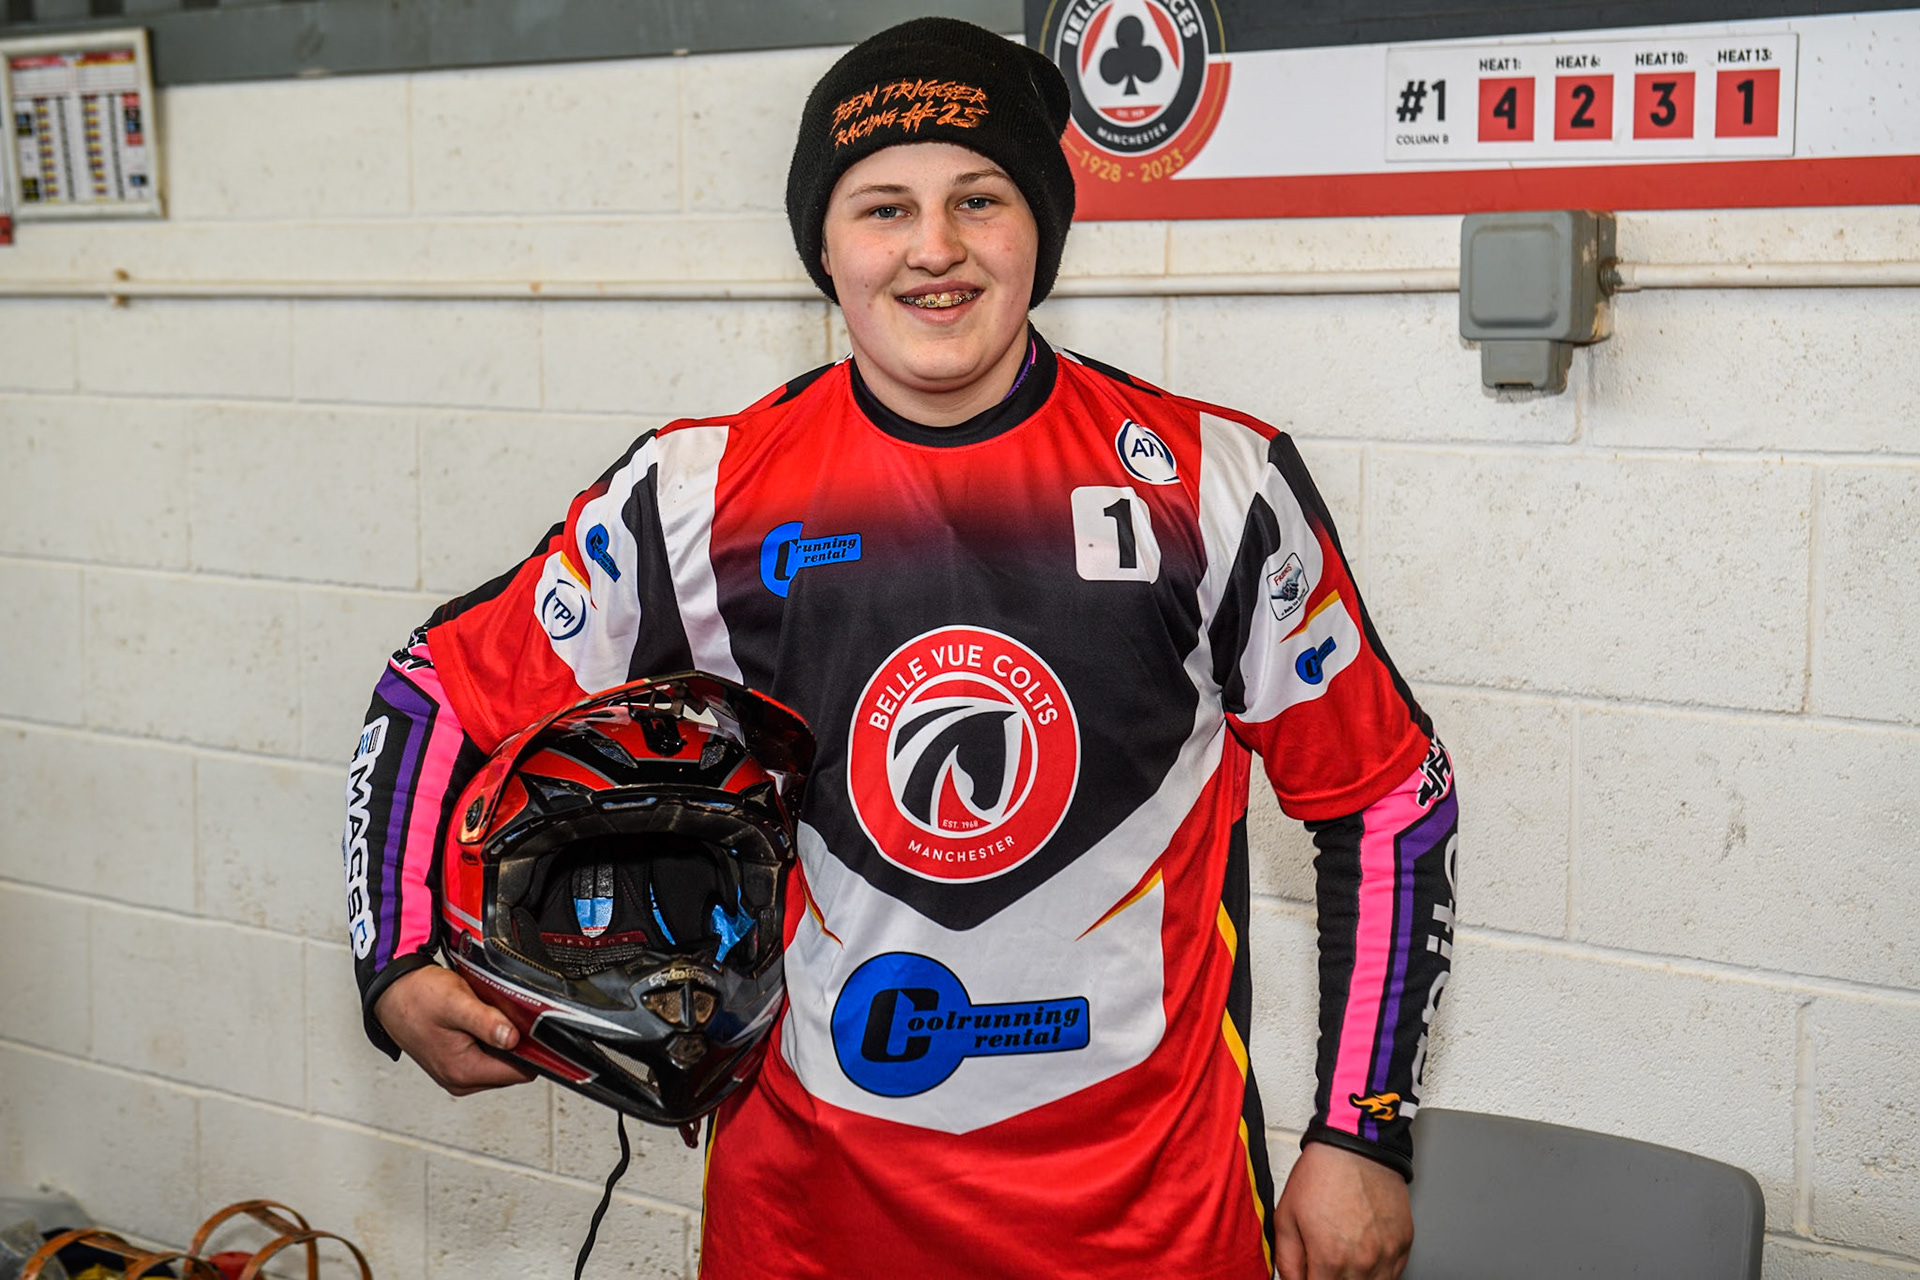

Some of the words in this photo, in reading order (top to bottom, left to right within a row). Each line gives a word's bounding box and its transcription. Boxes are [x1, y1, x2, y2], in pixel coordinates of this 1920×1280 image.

[1162, 0, 1199, 39] CES
[1479, 59, 1509, 71] HEAT
[1512, 58, 1522, 70] 1:
[1555, 56, 1588, 69] HEAT
[1591, 55, 1601, 67] 6:
[1635, 53, 1667, 66] HEAT
[1671, 52, 1688, 64] 10:
[1717, 50, 1752, 63] HEAT
[1755, 48, 1772, 62] 13:
[829, 84, 879, 136] BEN
[880, 78, 989, 110] TRIGGER
[1396, 79, 1447, 122] #1
[1493, 86, 1517, 130] 4
[1570, 84, 1595, 129] 2
[1650, 81, 1677, 127] 3
[1736, 79, 1754, 125] 1
[834, 107, 899, 150] RACING
[897, 100, 990, 133] #25
[1096, 122, 1168, 146] MANCHESTER
[1396, 134, 1440, 146] COLUMN
[1440, 134, 1449, 145] B
[1079, 150, 1122, 183] 1928
[1139, 149, 1184, 183] 2023
[1103, 497, 1137, 569] 1
[803, 548, 847, 563] rental
[868, 657, 928, 732] BELLE
[931, 644, 984, 669] VUE
[992, 654, 1059, 727] COLTS
[942, 819, 960, 829] EST.
[961, 820, 979, 829] 1968
[908, 835, 1016, 862] MANCHESTER
[861, 987, 1080, 1063] Coolrunning
[973, 1026, 1062, 1049] rental
